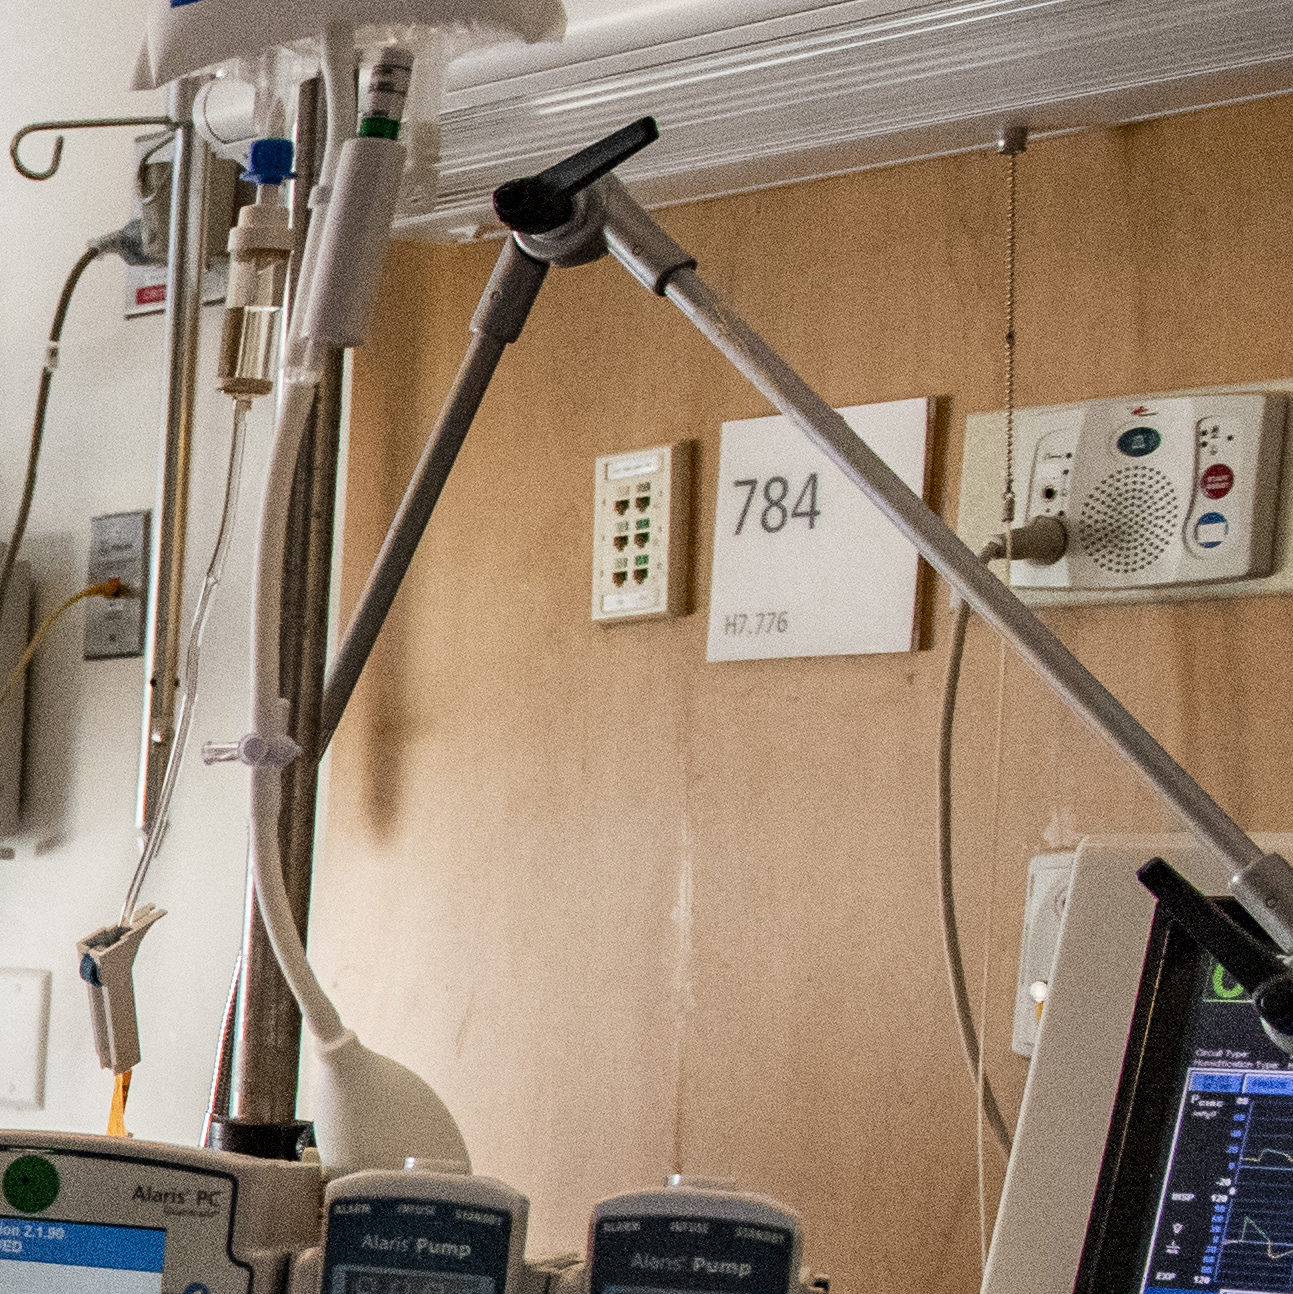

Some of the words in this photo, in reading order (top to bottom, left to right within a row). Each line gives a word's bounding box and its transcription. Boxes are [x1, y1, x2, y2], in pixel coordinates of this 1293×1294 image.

[733, 472, 820, 536] 784
[724, 611, 788, 635] H7.776
[132, 1185, 186, 1205] Alaris
[196, 1190, 221, 1208] PC
[362, 1233, 409, 1252] Alaris
[415, 1238, 472, 1260] Pump
[630, 1253, 683, 1272] Alaris
[693, 1257, 752, 1278] Pump
